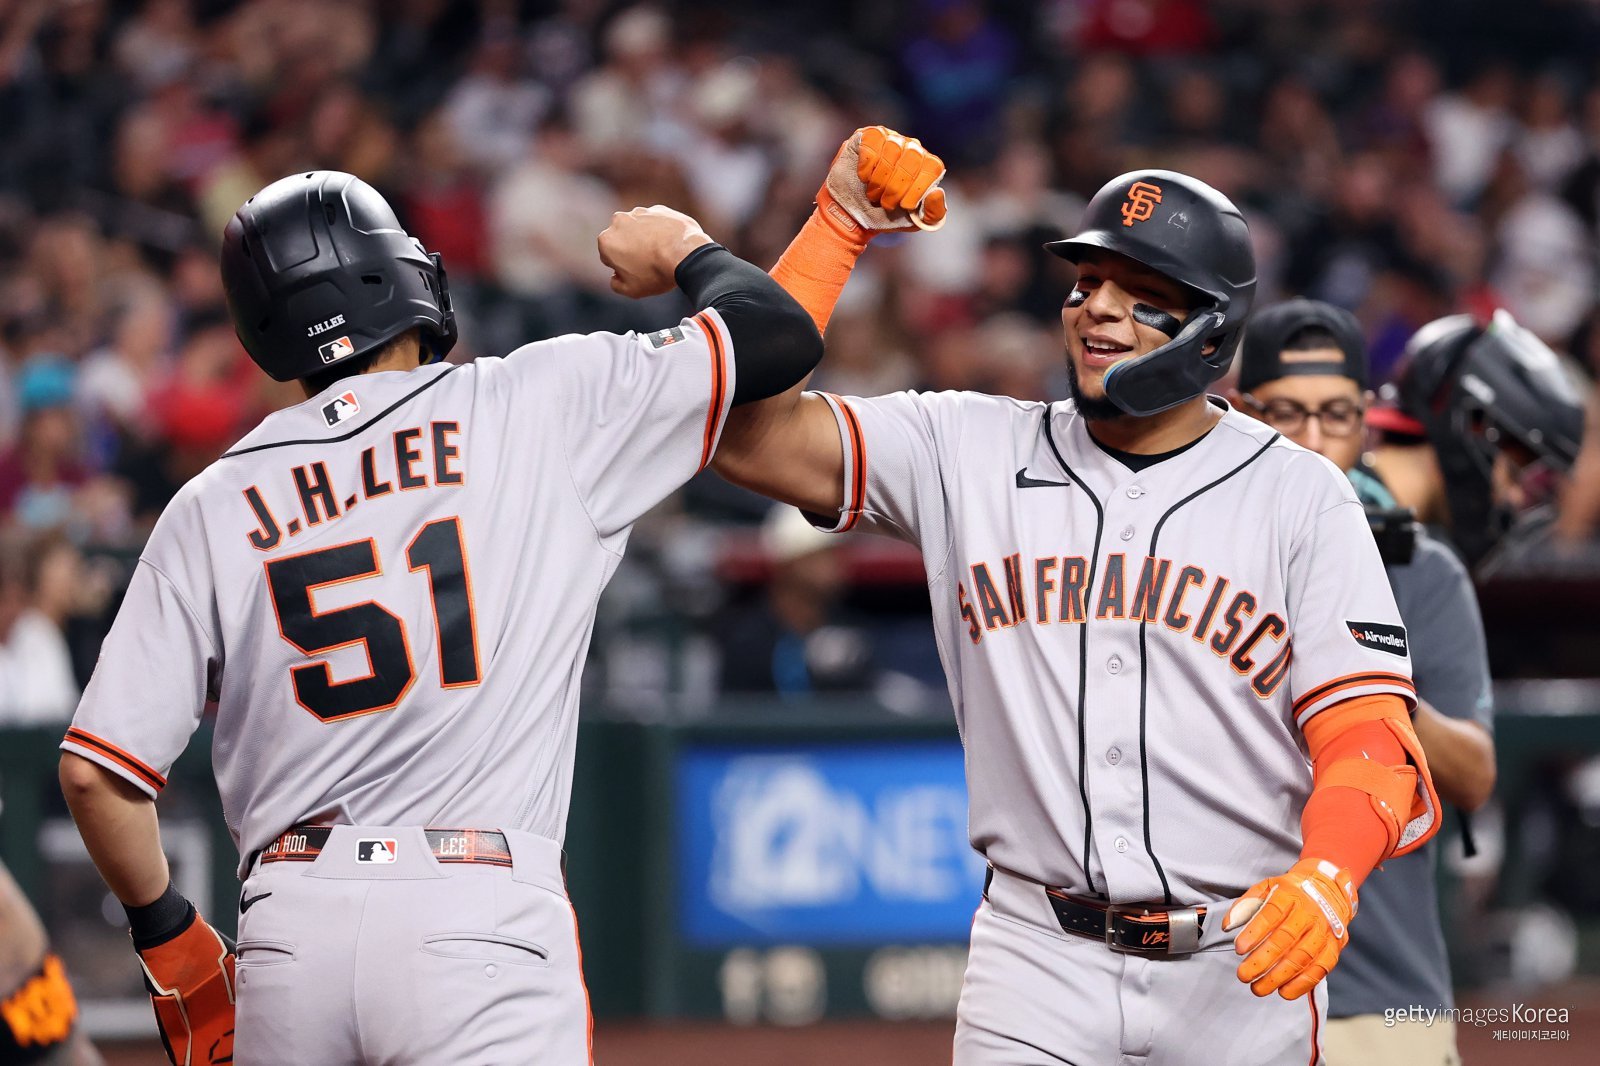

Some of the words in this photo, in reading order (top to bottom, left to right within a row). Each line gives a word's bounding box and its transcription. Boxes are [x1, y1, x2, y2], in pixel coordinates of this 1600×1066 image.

[1120, 181, 1163, 227] SF
[307, 313, 346, 337] J.H.LEE
[243, 421, 465, 552] J.H.LEE
[263, 516, 482, 724] 51
[958, 553, 1027, 645] SAN
[1034, 553, 1293, 699] FRANCISCO
[1364, 630, 1405, 648] Airwallex
[282, 835, 307, 853] HOO
[440, 837, 467, 855] LEE
